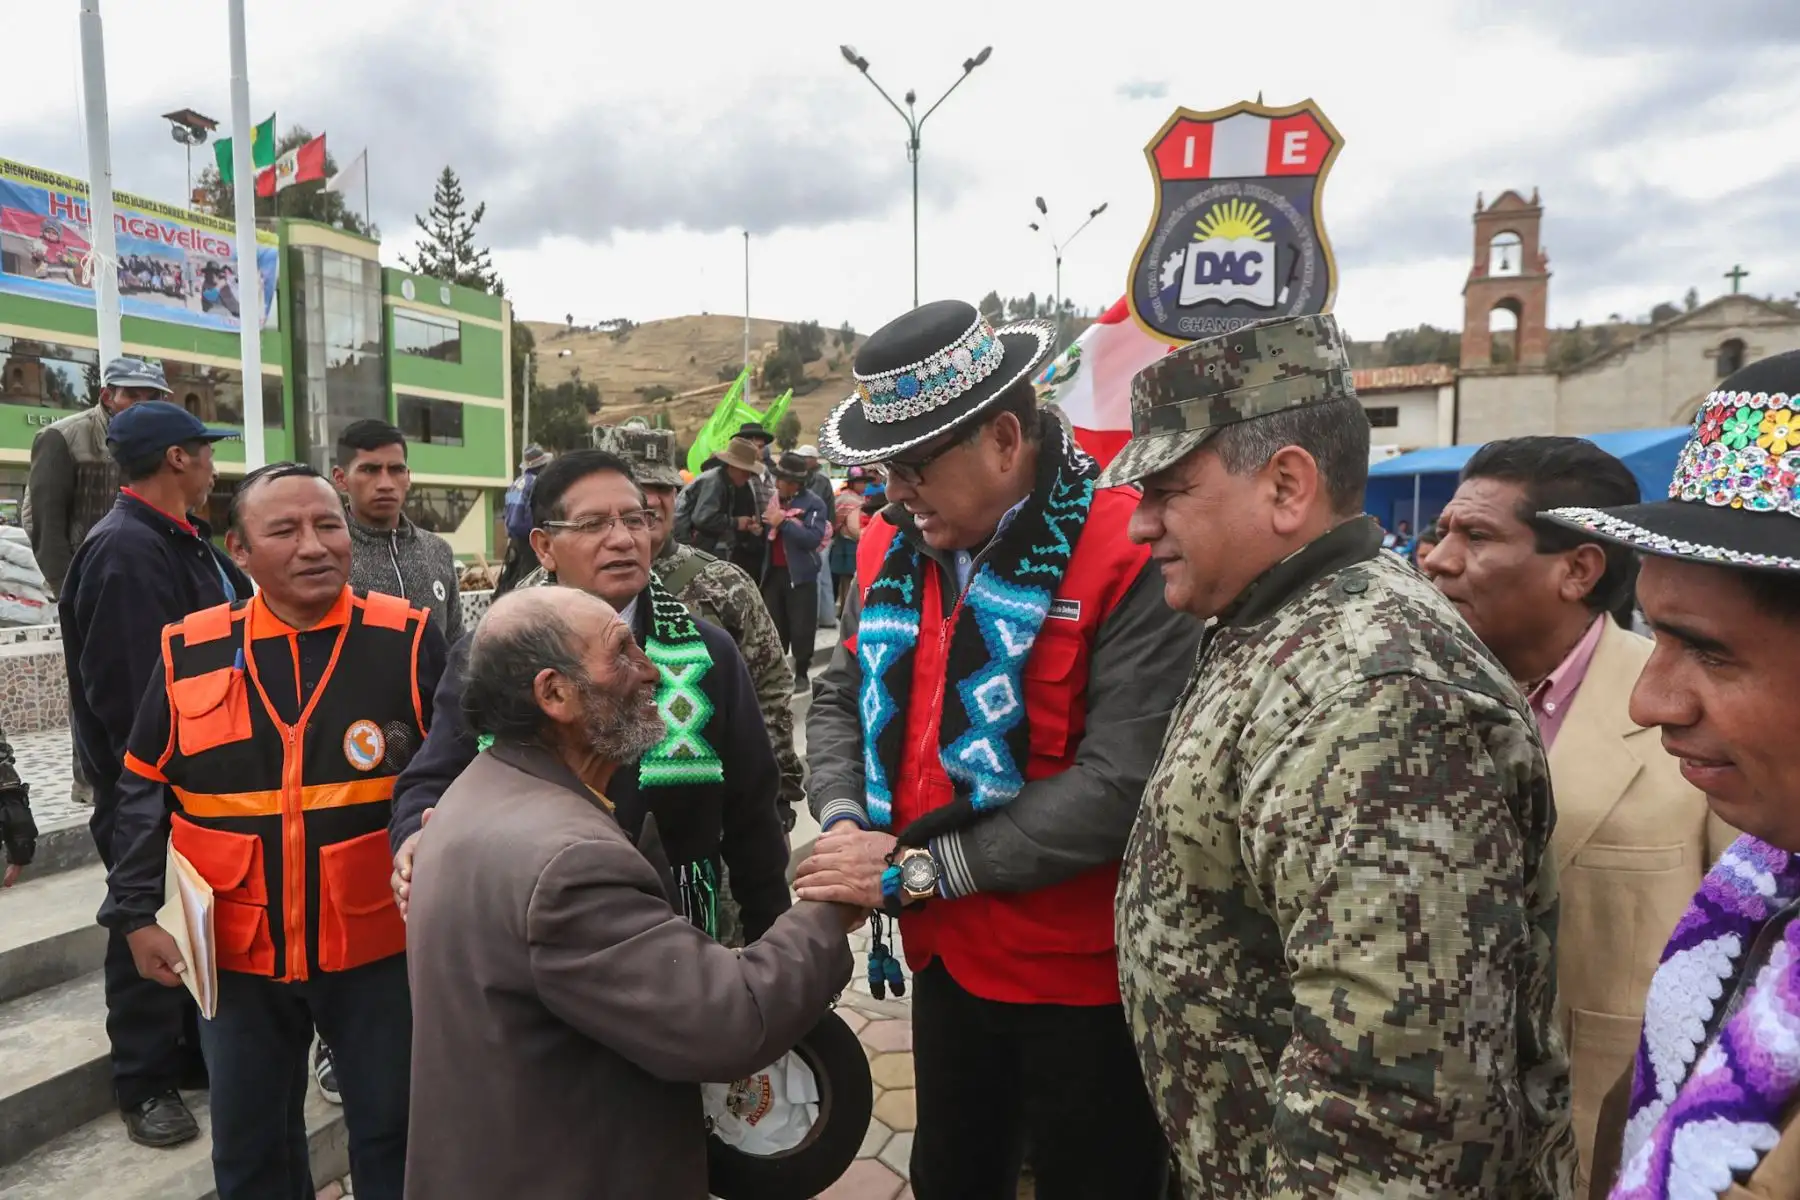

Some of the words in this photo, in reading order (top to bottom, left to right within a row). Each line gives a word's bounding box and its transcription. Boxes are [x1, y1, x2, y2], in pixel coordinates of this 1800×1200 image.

[1184, 136, 1195, 168] I
[1282, 131, 1308, 165] E
[49, 191, 231, 257] Huncavelica
[1194, 251, 1263, 286] DAC
